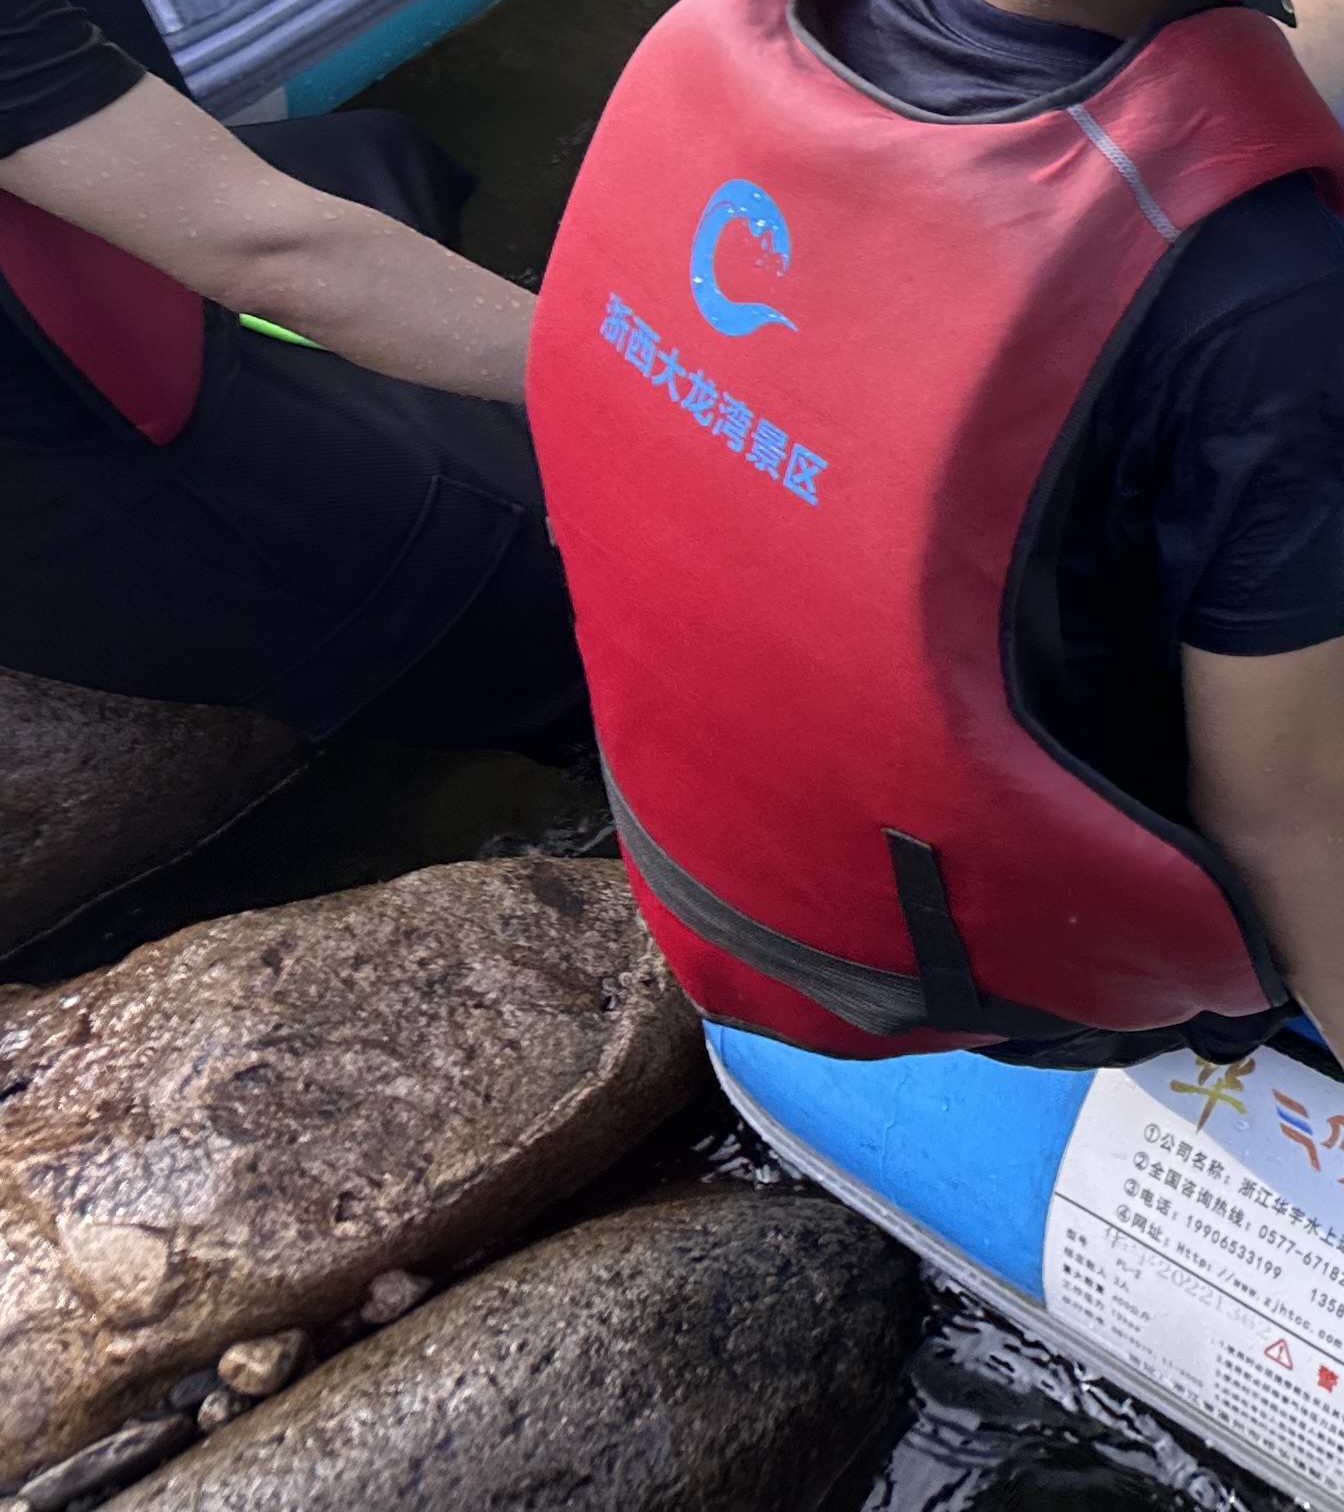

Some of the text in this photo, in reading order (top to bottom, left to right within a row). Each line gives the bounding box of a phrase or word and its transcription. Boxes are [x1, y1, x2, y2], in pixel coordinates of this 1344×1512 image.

[599, 291, 828, 506] 浙西大龙湾景区
